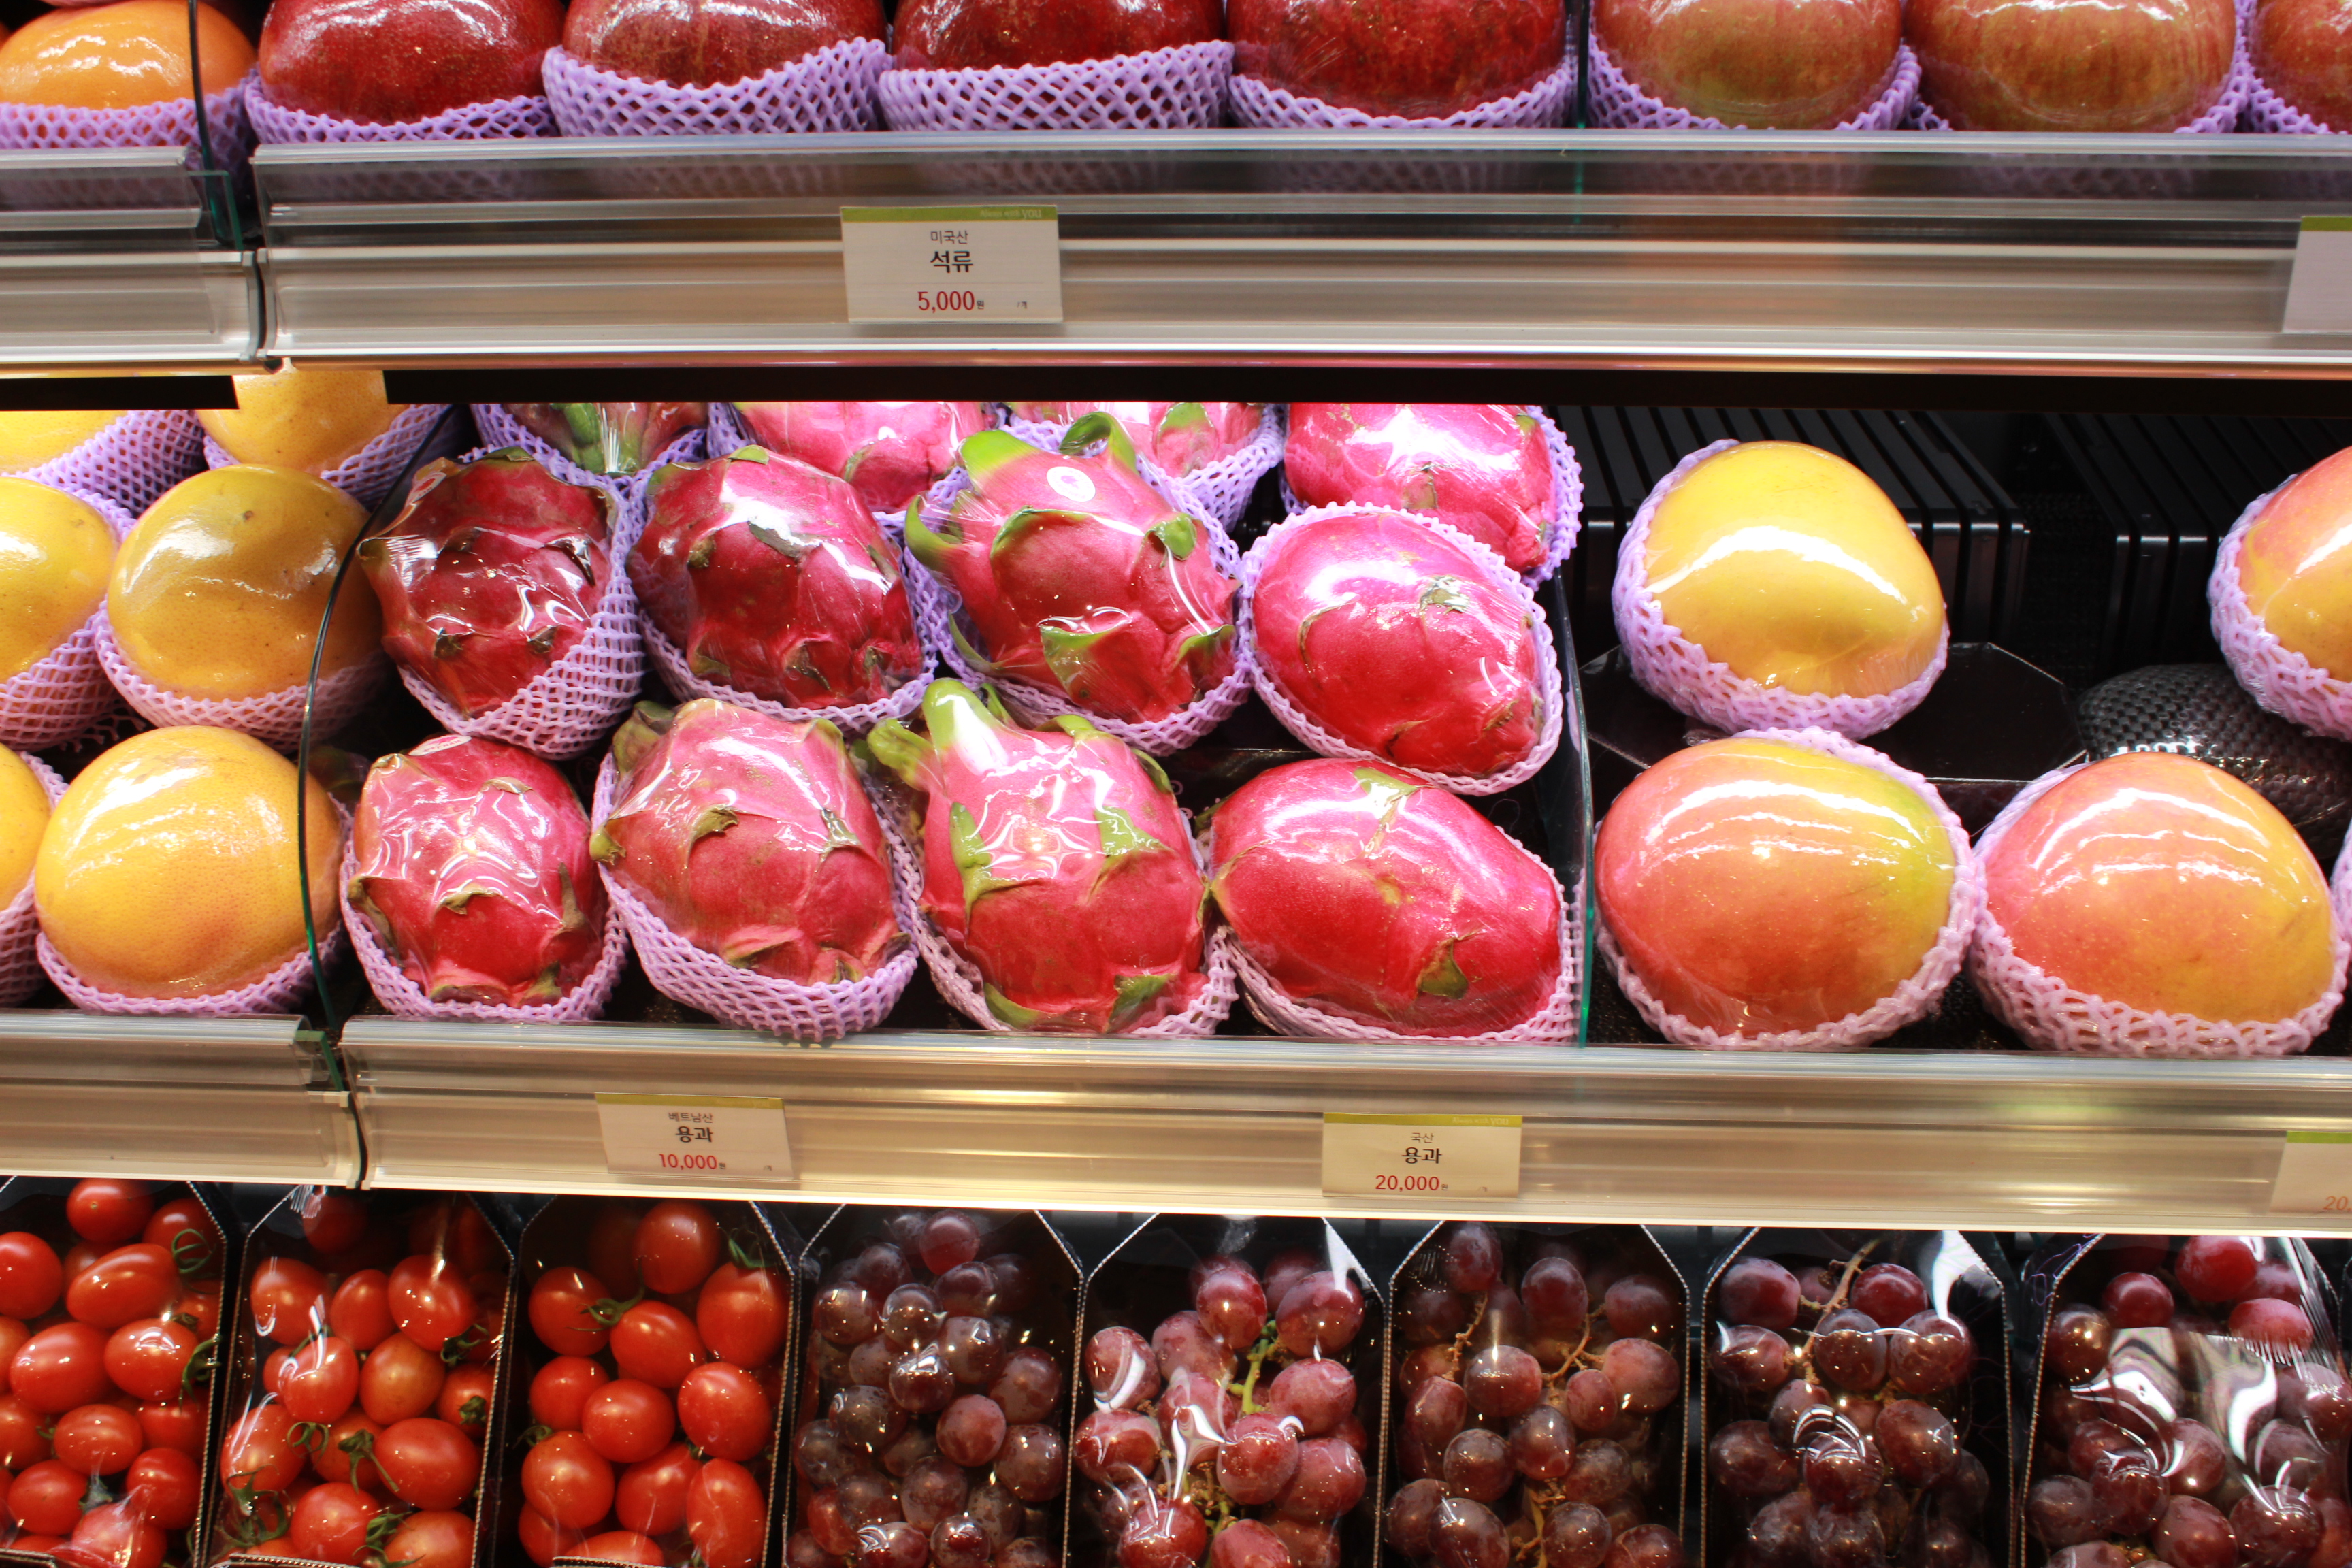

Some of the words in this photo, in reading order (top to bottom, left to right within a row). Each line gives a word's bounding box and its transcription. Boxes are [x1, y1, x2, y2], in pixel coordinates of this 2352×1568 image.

[930, 230, 968, 244] 미국산
[930, 250, 973, 273] 석류
[668, 1111, 713, 1123] 베트남산
[675, 1126, 714, 1143] 용과
[1410, 1132, 1434, 1143] 국산
[1402, 1147, 1442, 1164] 용과
